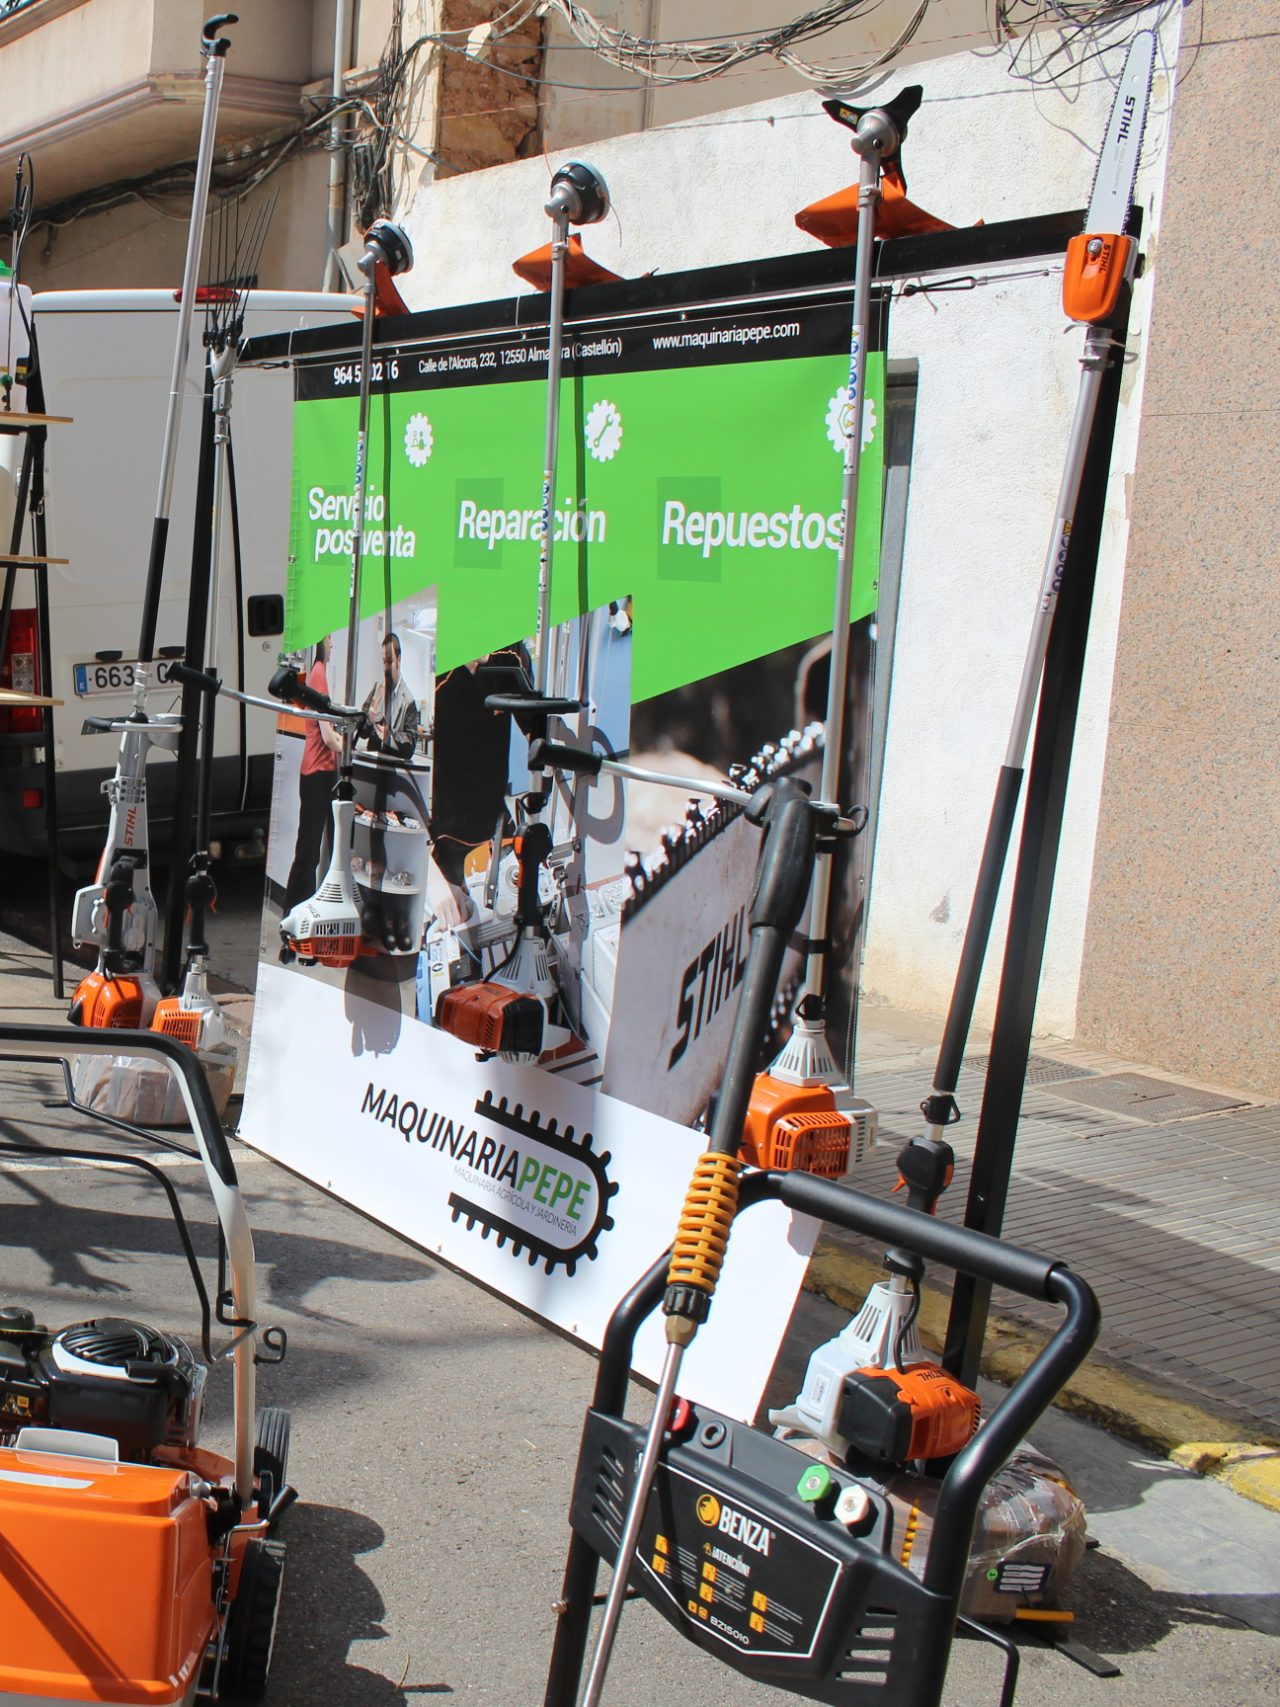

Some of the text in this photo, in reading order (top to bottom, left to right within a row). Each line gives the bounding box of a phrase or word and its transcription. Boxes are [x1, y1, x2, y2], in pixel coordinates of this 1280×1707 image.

[1116, 95, 1136, 144] STIHL
[1098, 243, 1111, 273] STIHL
[418, 358, 437, 374] Calle
[438, 359, 448, 371] de
[448, 353, 479, 371] l'Alcora,
[480, 352, 497, 369] 232,
[500, 348, 526, 364] 12550
[571, 336, 622, 358] (Castellón)
[652, 322, 800, 350] www.maquinariapepe.com
[333, 366, 353, 386] 964
[385, 360, 399, 380] 16
[308, 485, 385, 522] Servio
[457, 498, 606, 550] Reparación
[662, 500, 844, 559] Repuestos
[94, 664, 140, 689] 663
[124, 806, 137, 847] STIHL
[667, 904, 748, 1073] STIHL
[453, 1165, 496, 1195] MAQUINARIA
[495, 1185, 531, 1214] AGRÍCOLA
[534, 1206, 578, 1237] JARDINERÍA
[718, 1504, 770, 1557] BENZA
[712, 1545, 751, 1578] ¡ATENCIÓN!
[709, 1615, 750, 1645] BZ15010
